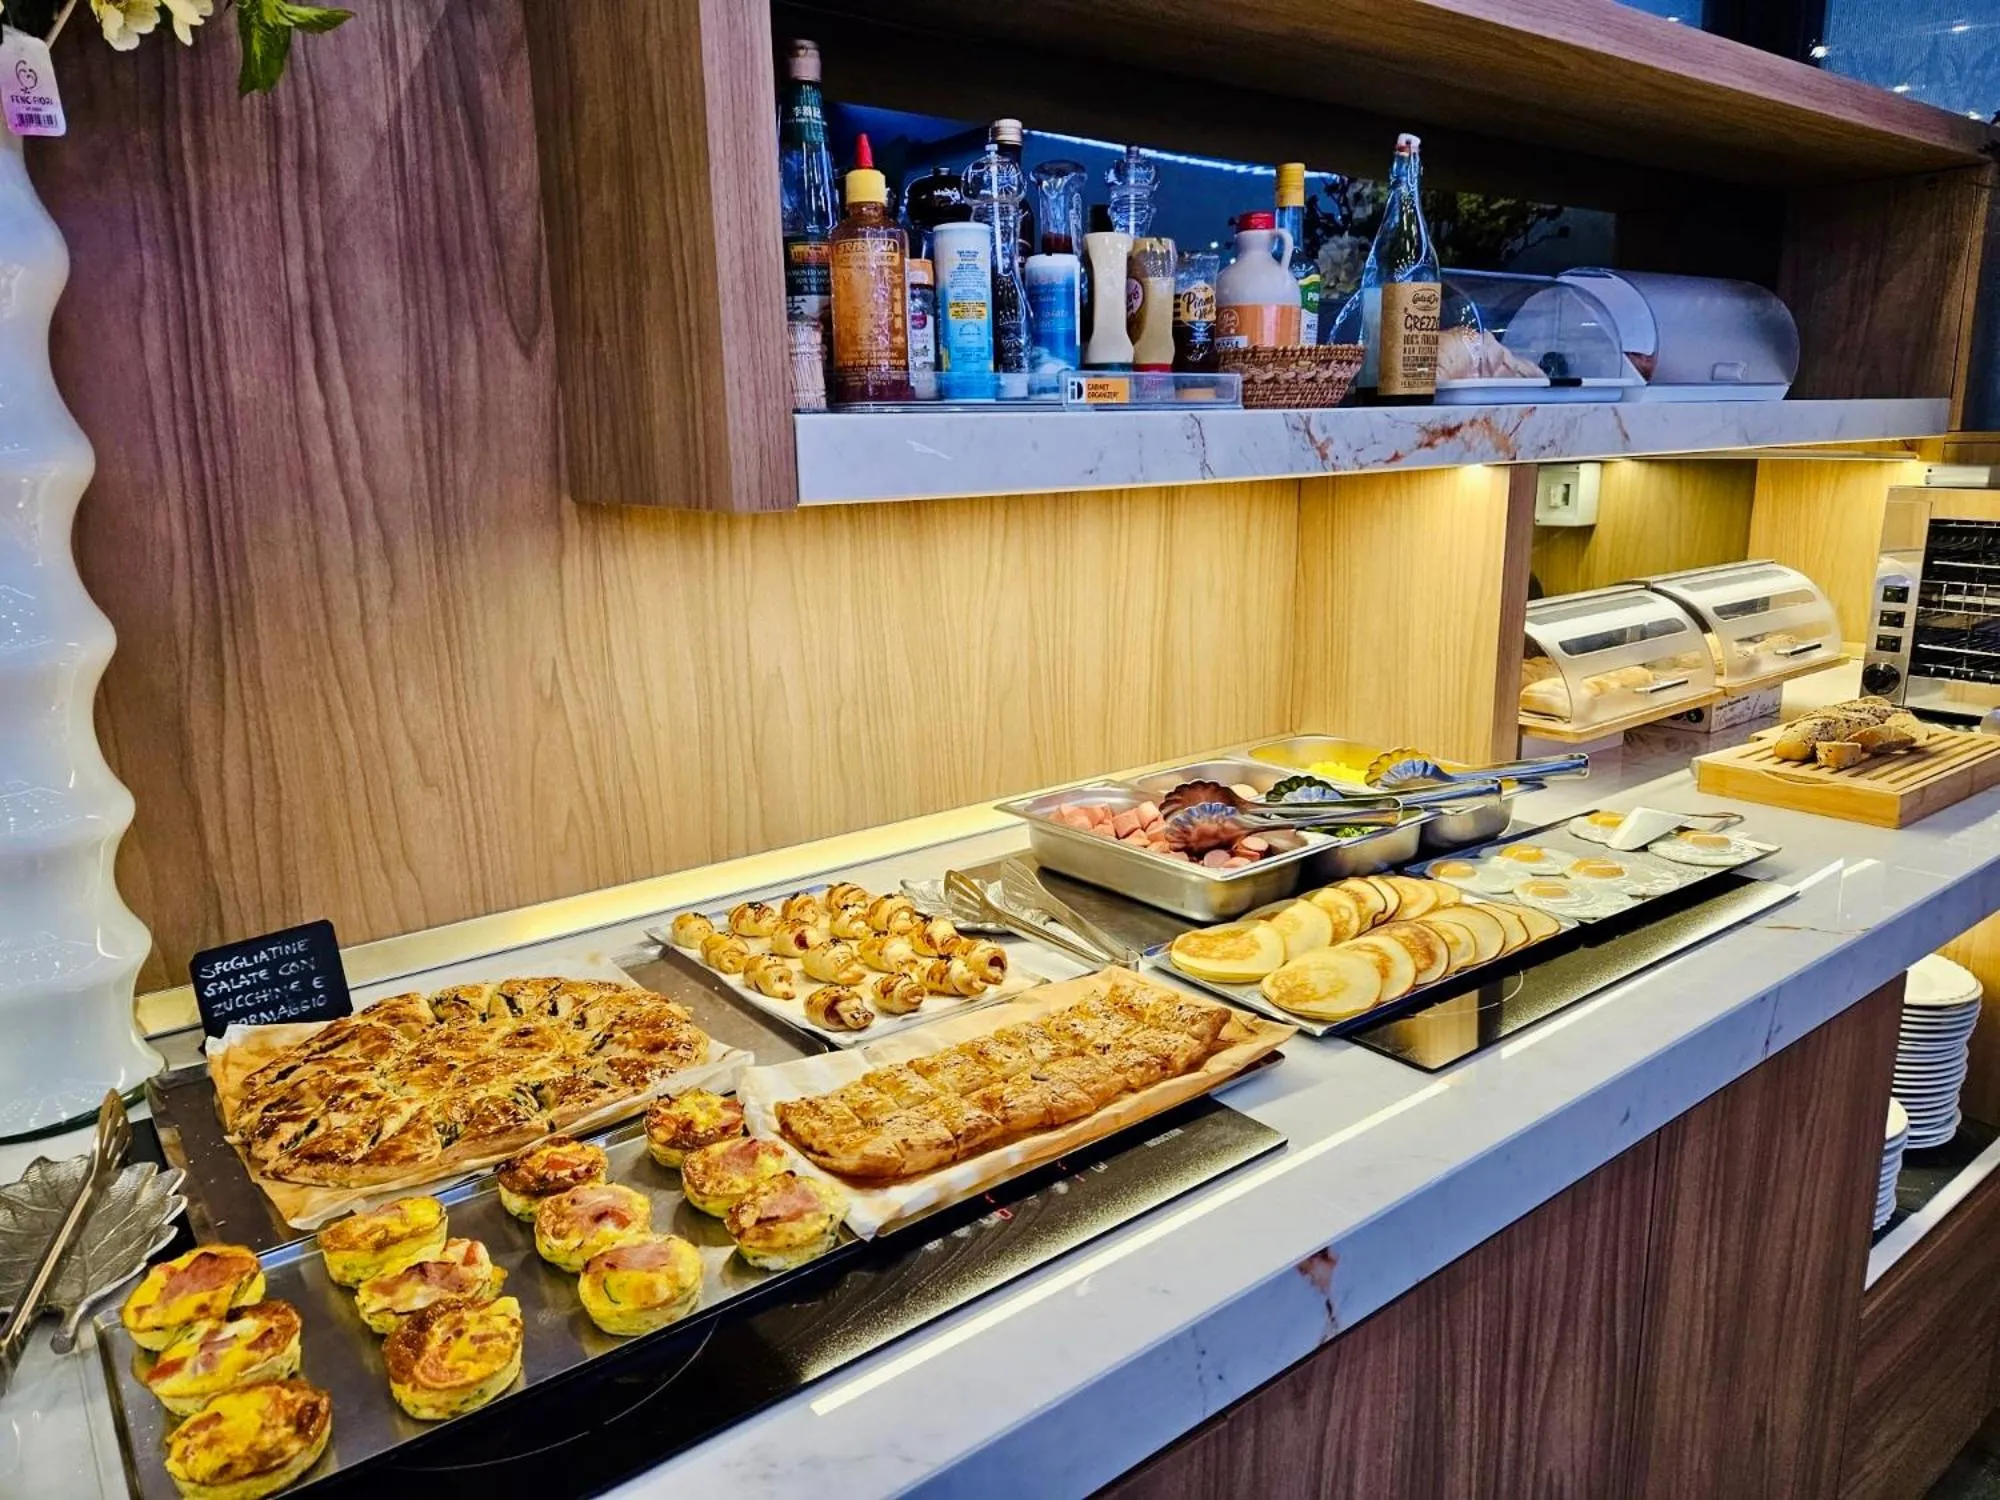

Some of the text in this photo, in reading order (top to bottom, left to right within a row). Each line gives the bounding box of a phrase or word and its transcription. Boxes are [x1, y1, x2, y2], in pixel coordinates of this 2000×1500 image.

[199, 938, 309, 979] SFOGLIATINE
[203, 956, 317, 998] SALATE CON
[211, 975, 327, 1018] ZUCCHINE E
